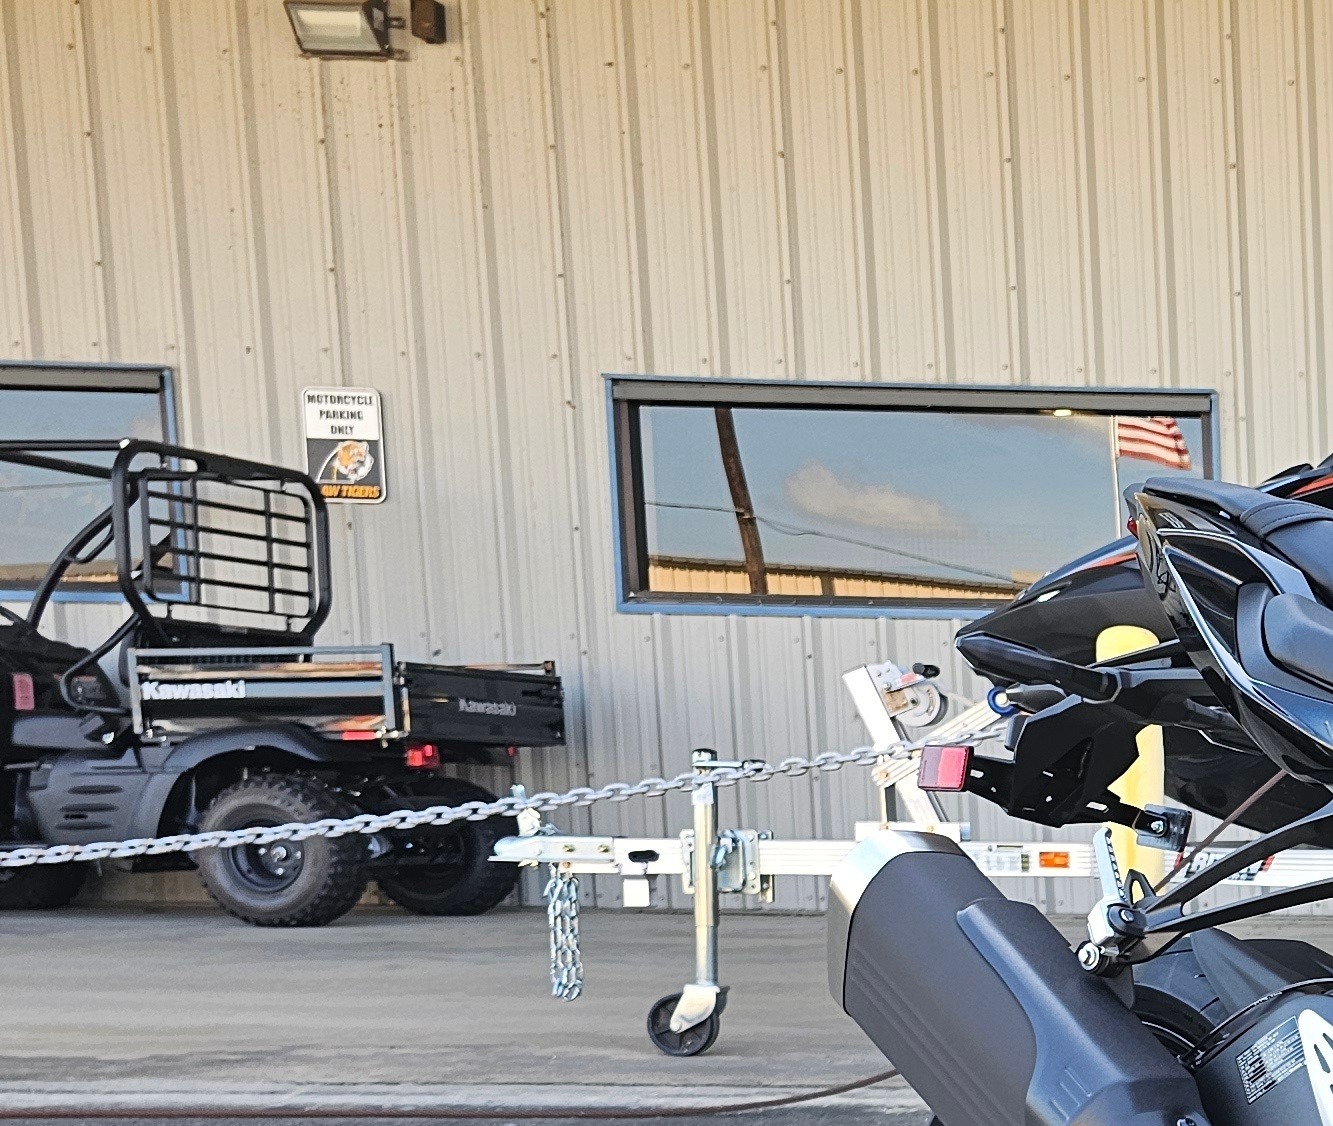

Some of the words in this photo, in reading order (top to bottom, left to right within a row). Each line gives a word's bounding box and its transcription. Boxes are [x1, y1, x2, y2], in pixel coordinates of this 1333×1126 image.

[307, 394, 373, 405] MOTORCYCLE
[319, 409, 364, 420] PARKING
[330, 425, 355, 435] ONLY
[141, 679, 246, 700] Kawasaki
[458, 697, 517, 717] Kawasaki
